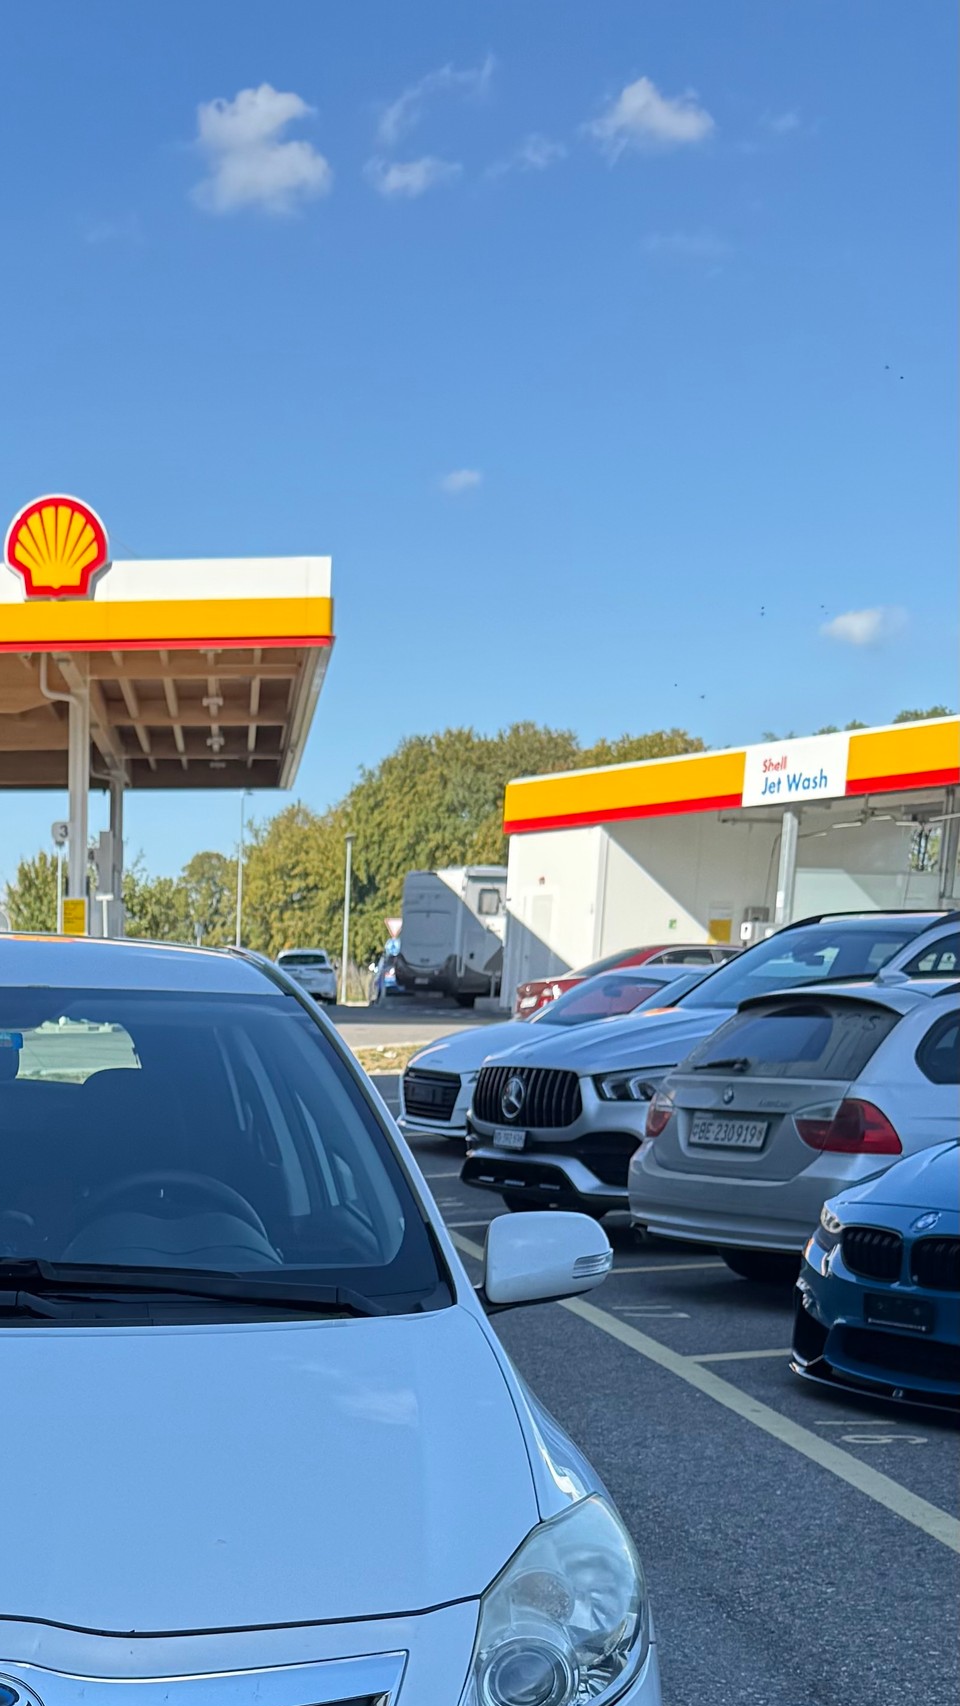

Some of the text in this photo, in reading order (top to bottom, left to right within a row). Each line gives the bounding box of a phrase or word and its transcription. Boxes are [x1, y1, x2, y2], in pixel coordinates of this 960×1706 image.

[762, 755, 787, 773] Shell
[761, 768, 828, 795] Jet Wash
[59, 824, 69, 838] 3
